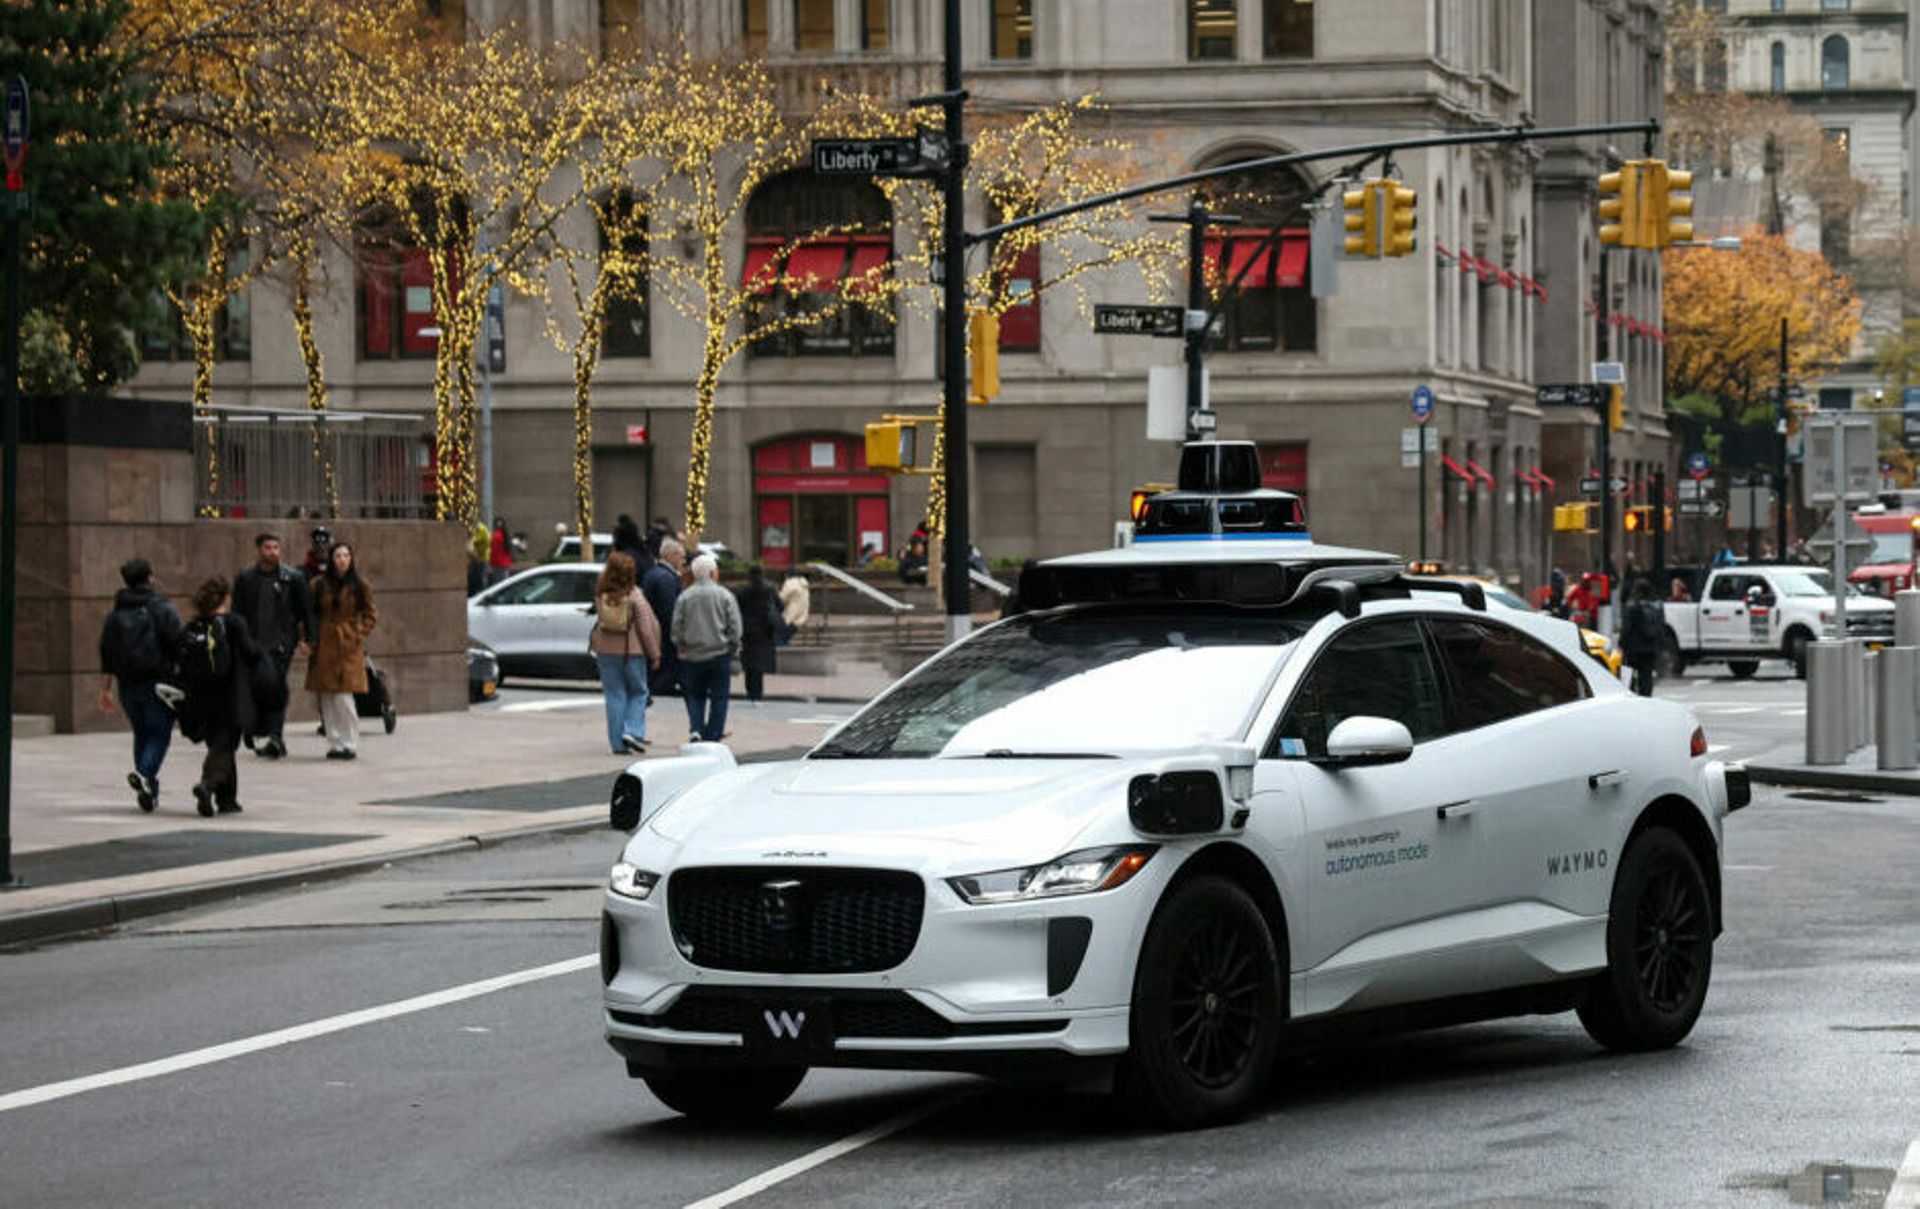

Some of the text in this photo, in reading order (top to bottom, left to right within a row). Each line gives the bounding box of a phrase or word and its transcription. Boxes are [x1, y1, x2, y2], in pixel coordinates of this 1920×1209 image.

[821, 149, 879, 171] Liberty
[1101, 311, 1143, 332] Liberty
[1326, 841, 1430, 875] autonomous mode
[1547, 849, 1608, 876] WAYMO
